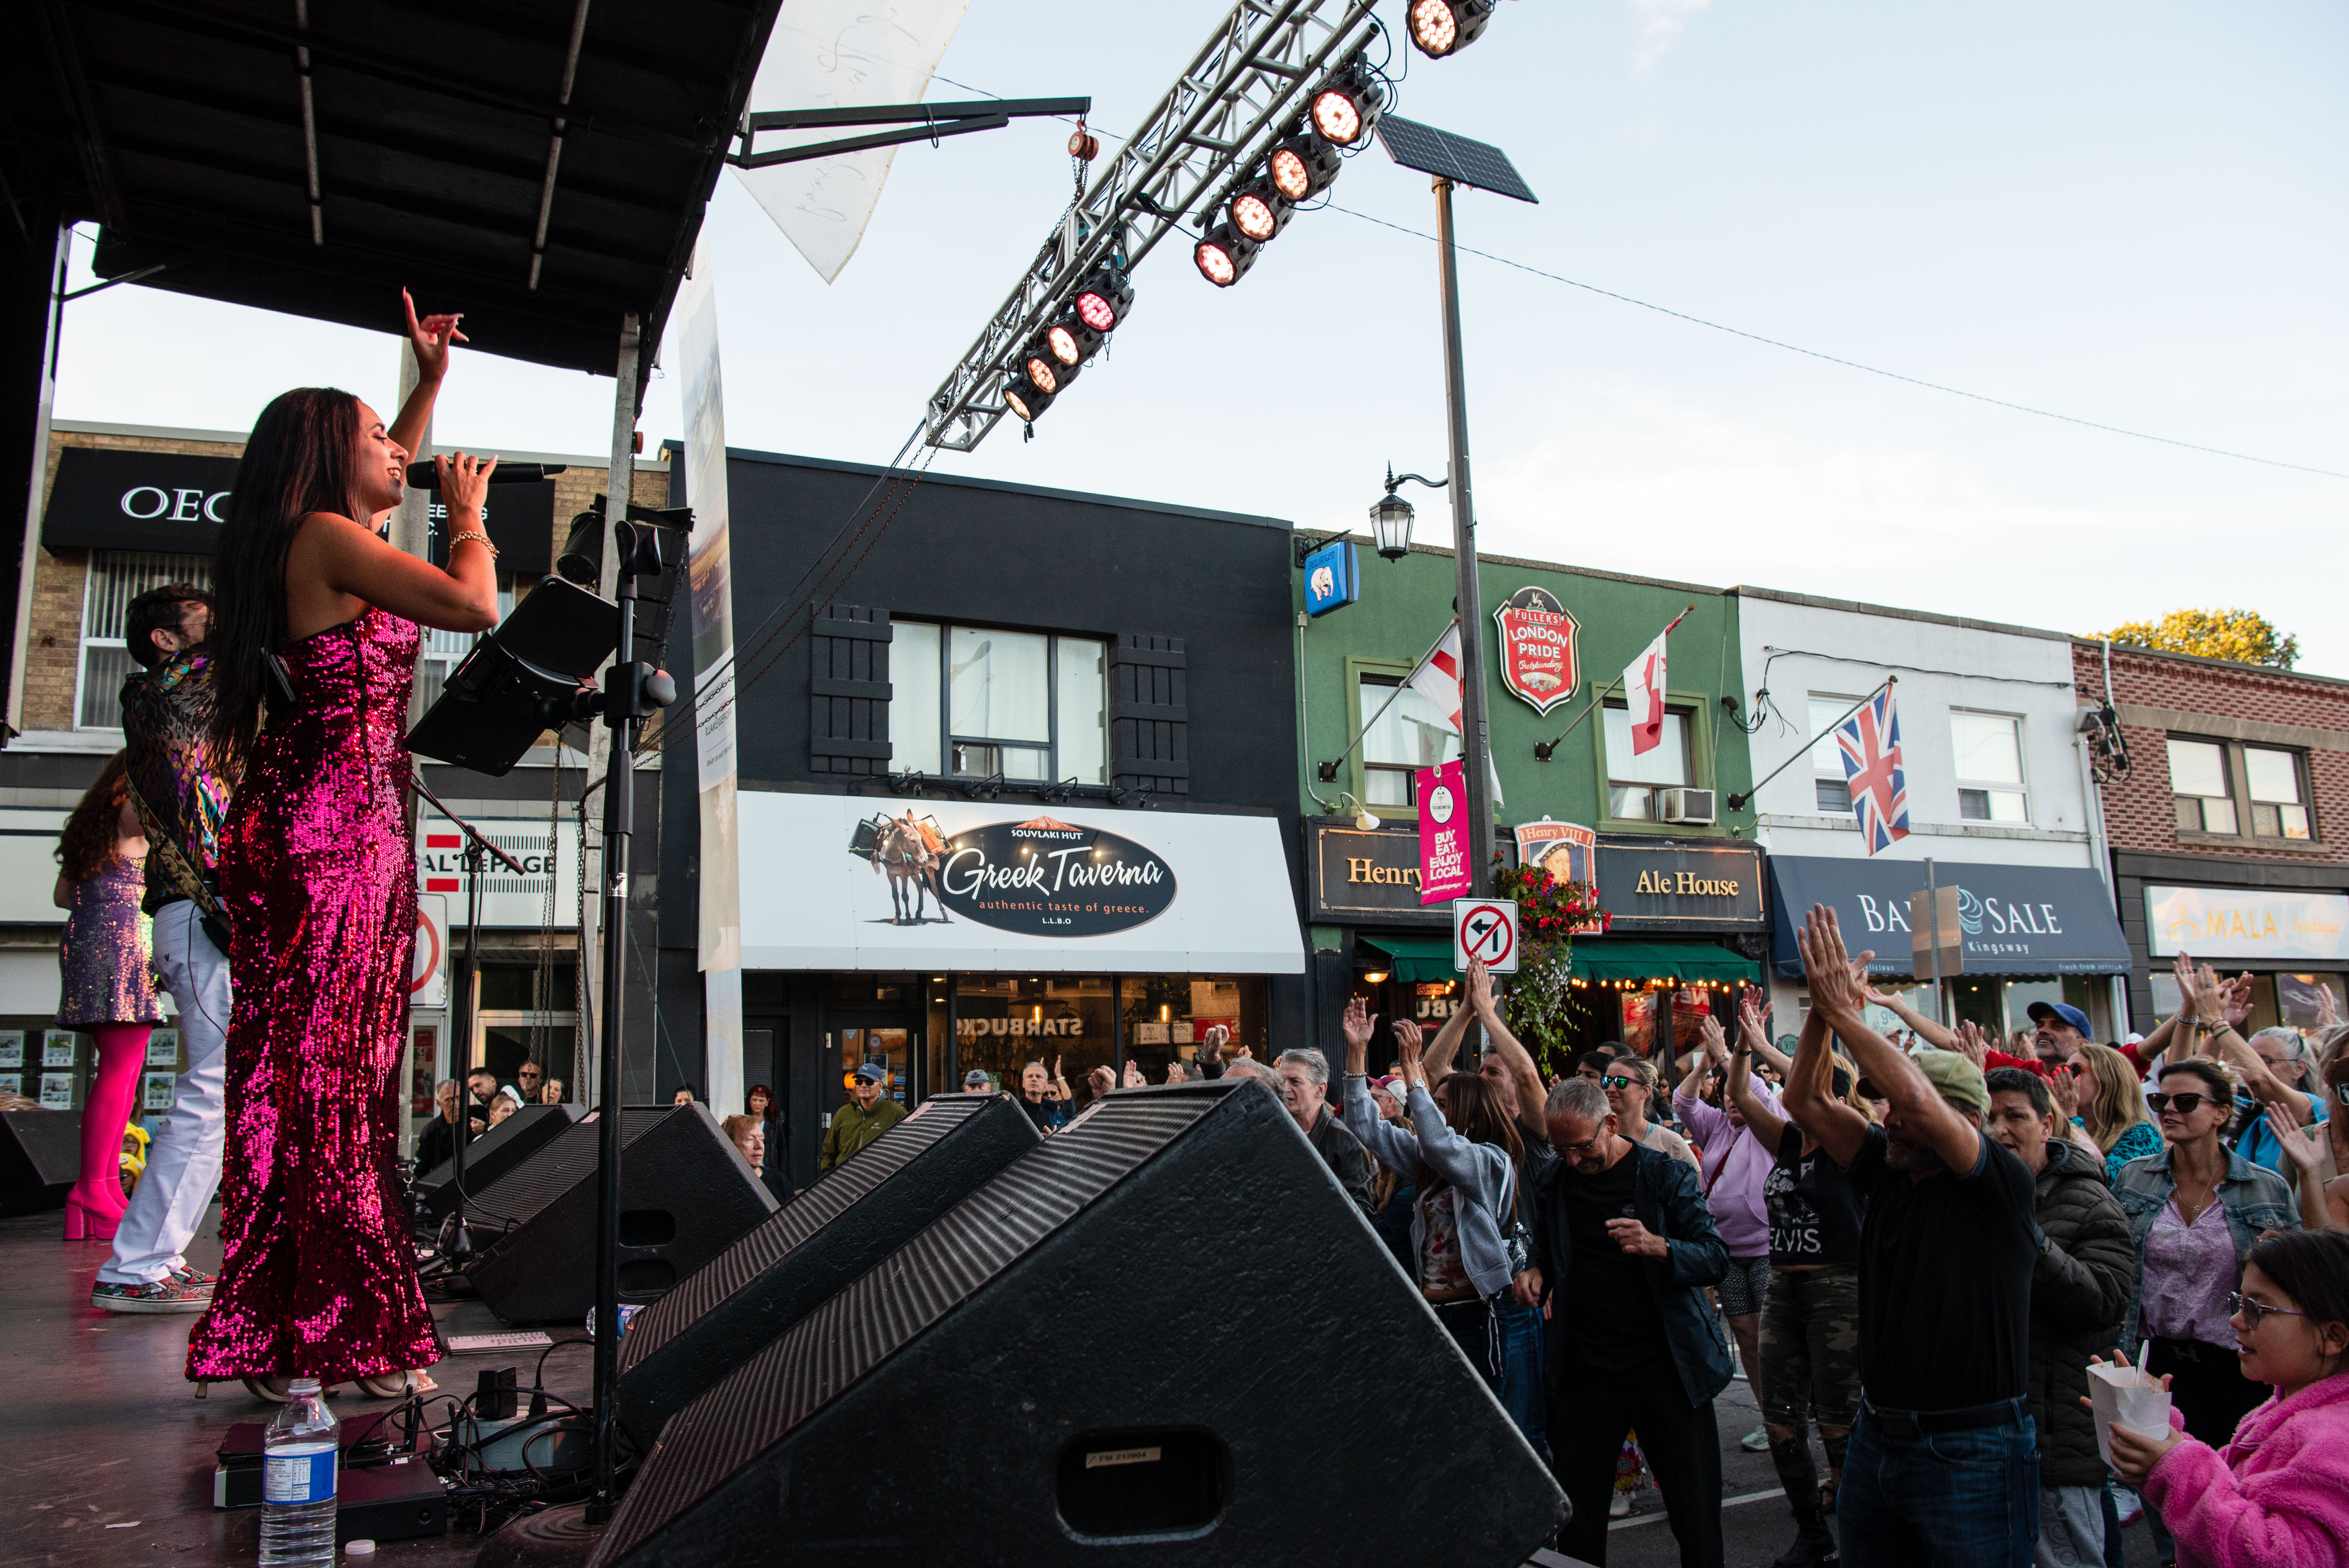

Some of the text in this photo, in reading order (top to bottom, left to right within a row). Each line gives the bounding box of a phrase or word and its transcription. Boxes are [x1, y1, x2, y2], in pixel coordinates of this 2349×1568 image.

[1308, 551, 1335, 570] DELIRIUM
[1515, 609, 1558, 624] FULLER'S
[1509, 627, 1567, 648] LONDON
[1519, 643, 1561, 659] PRIDE
[1518, 660, 1564, 672] Outstanding
[1012, 829, 1082, 840] SOUVLAKI HUT
[1435, 829, 1455, 844] BUY
[1526, 827, 1583, 841] Henry VIII
[1436, 842, 1456, 856] EAT
[1430, 852, 1463, 869] ENJOY
[944, 846, 1164, 900] Greek Taverna
[1347, 858, 1739, 896] Henry Ale House
[1430, 865, 1463, 880] LOCAL
[979, 901, 1149, 914] authentic taste of greece.
[1986, 898, 2062, 934] SALE
[2207, 907, 2341, 939] MALA boutique
[1967, 941, 2028, 955] Kingsway
